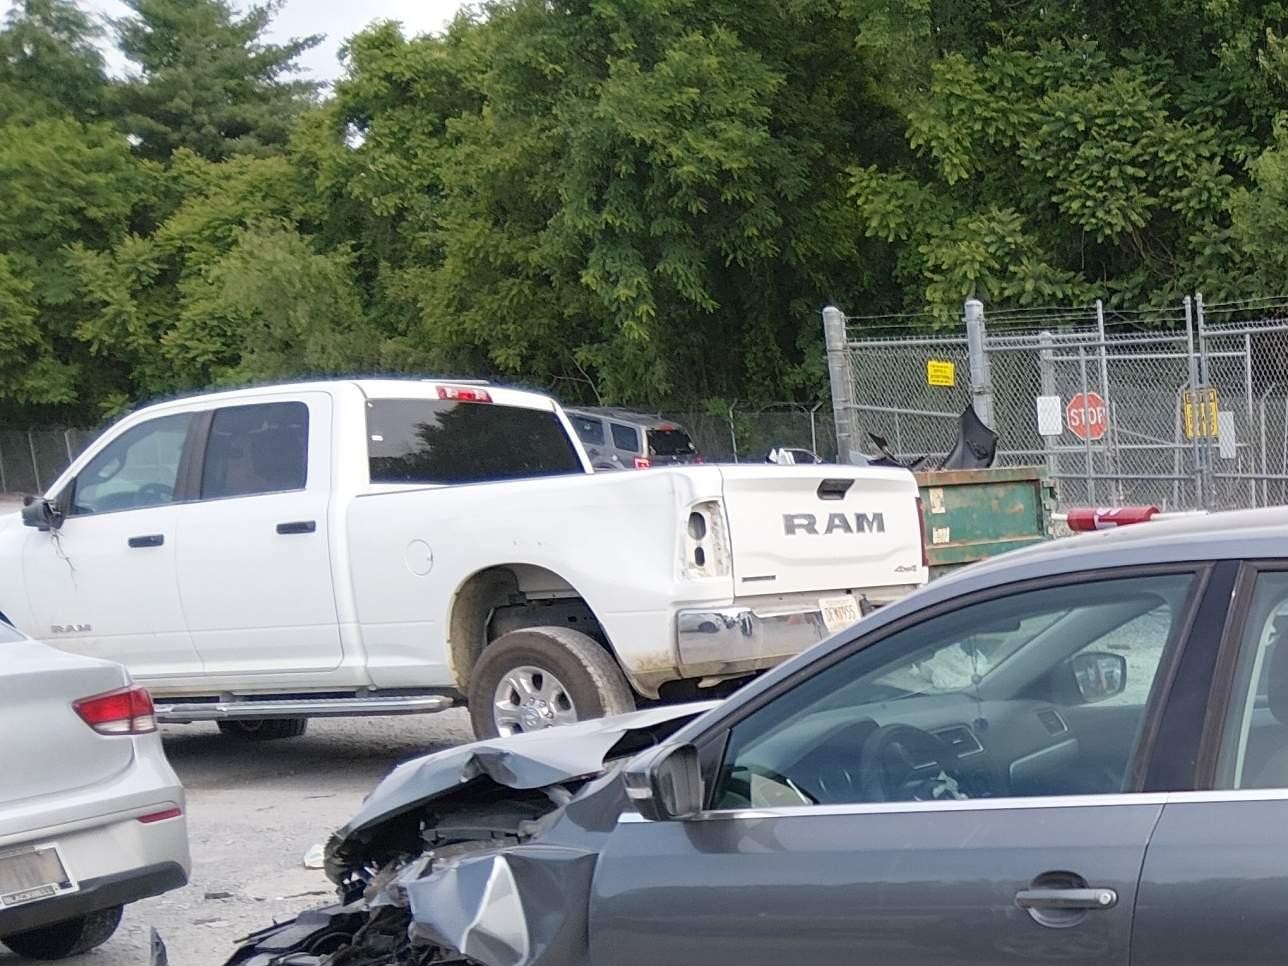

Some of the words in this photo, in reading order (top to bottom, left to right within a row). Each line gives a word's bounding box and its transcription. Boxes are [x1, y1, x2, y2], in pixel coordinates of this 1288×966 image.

[1070, 407, 1106, 426] STOP
[782, 512, 885, 535] RAM
[50, 624, 92, 634] RAM
